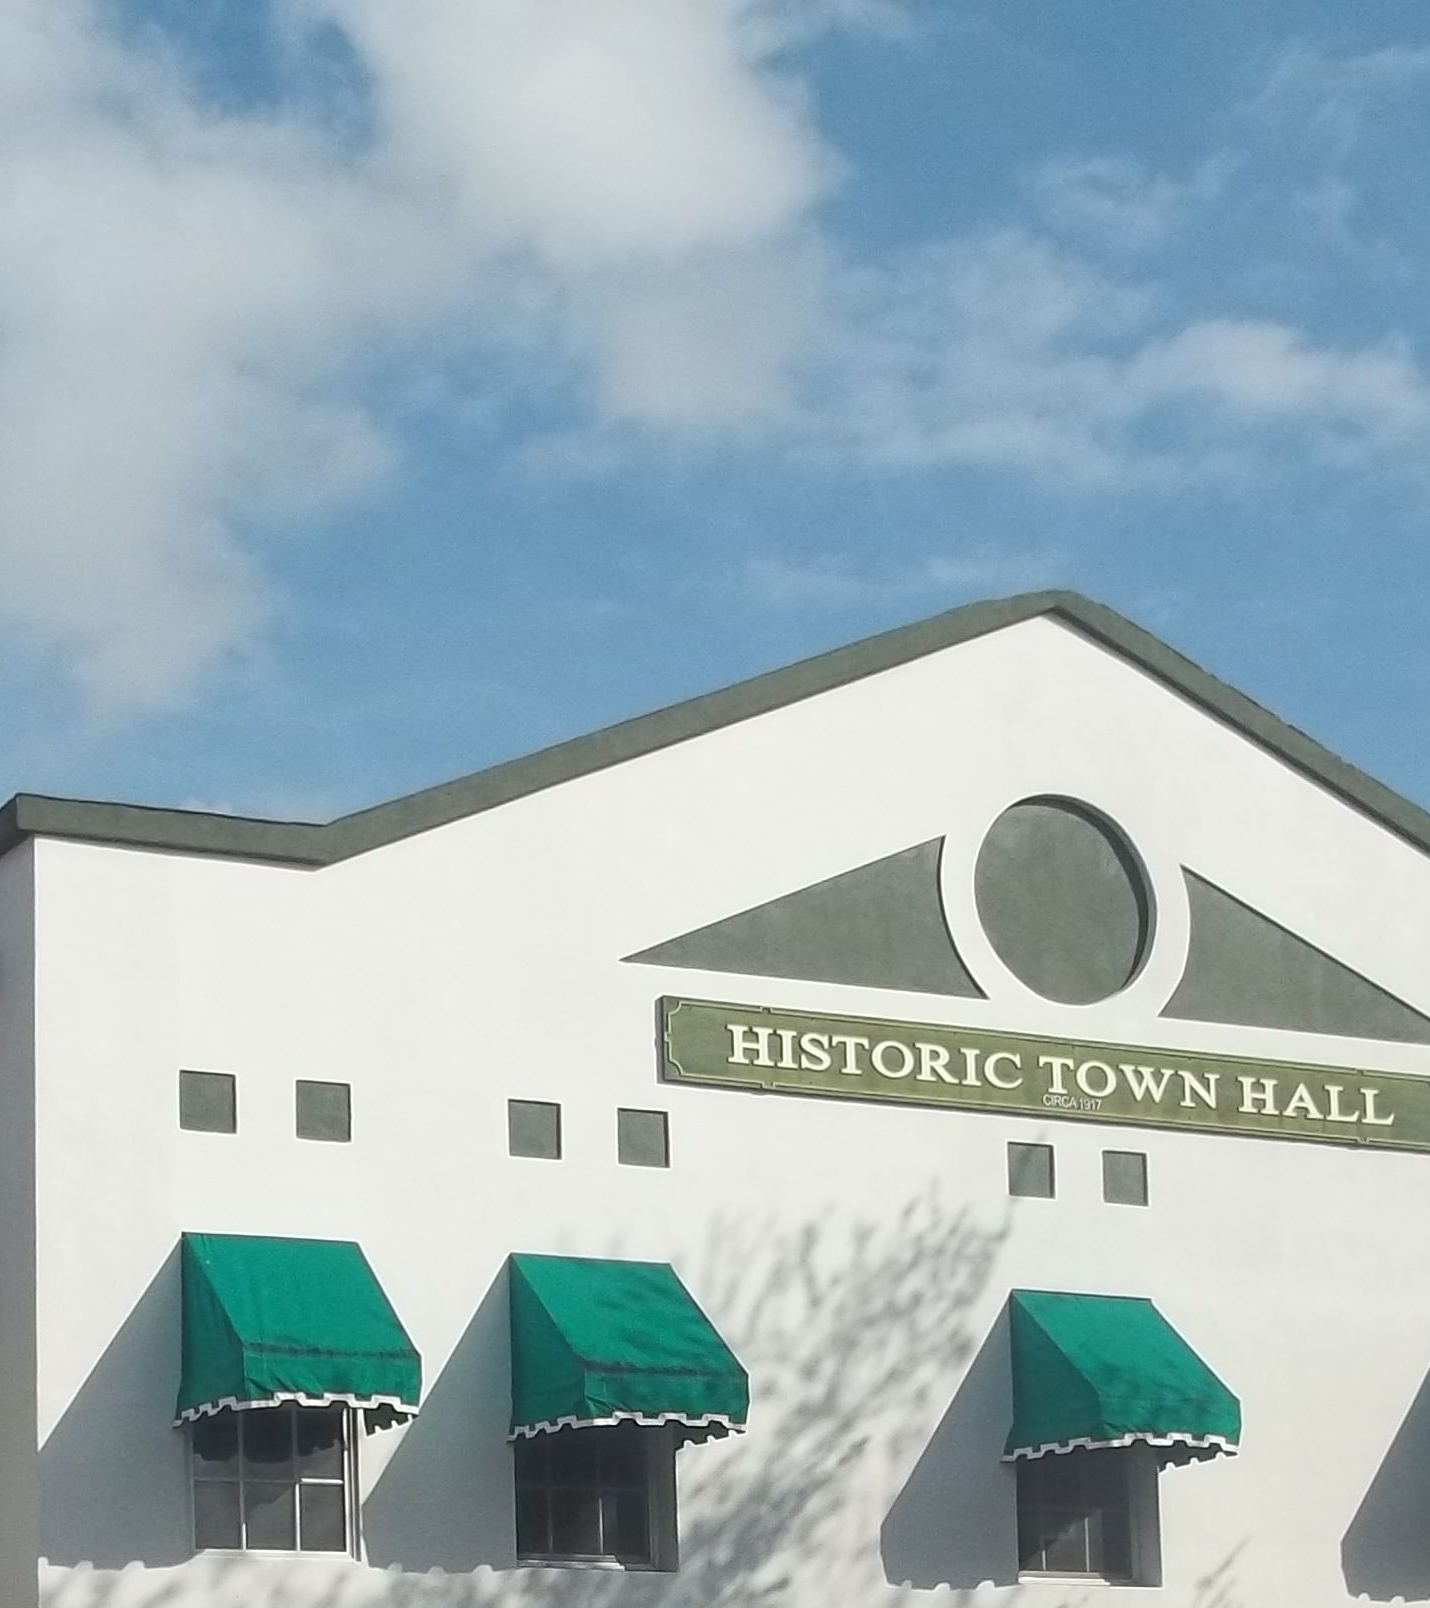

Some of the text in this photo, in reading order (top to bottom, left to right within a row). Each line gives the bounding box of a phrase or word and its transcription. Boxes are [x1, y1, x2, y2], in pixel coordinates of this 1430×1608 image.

[726, 1024, 1396, 1126] HISTORIC TOWN HALL
[1042, 1094, 1102, 1111] CIRCA 1917
